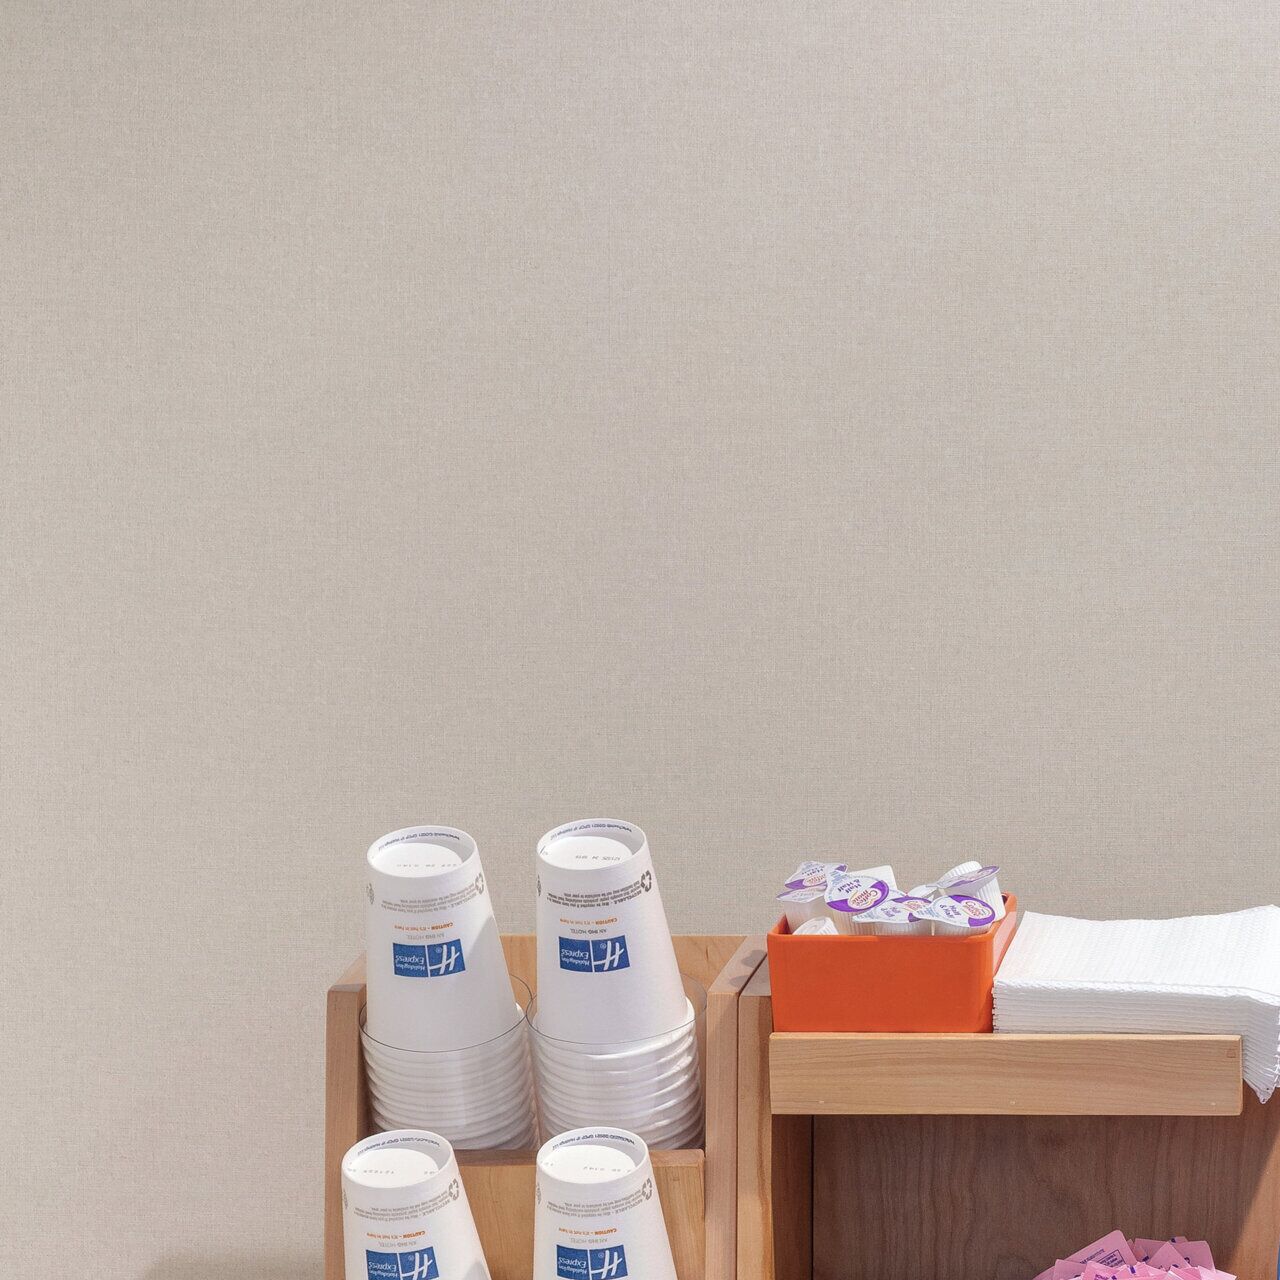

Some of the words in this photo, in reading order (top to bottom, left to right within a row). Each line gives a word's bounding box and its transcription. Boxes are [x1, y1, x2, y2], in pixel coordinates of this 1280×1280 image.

[595, 917, 618, 925] CAUTION
[431, 922, 454, 930] CAUTION
[561, 949, 589, 958] Express
[395, 955, 425, 963] Express
[403, 1230, 426, 1239] CAUTION
[368, 1261, 397, 1271] Express
[558, 1257, 587, 1268] Express
